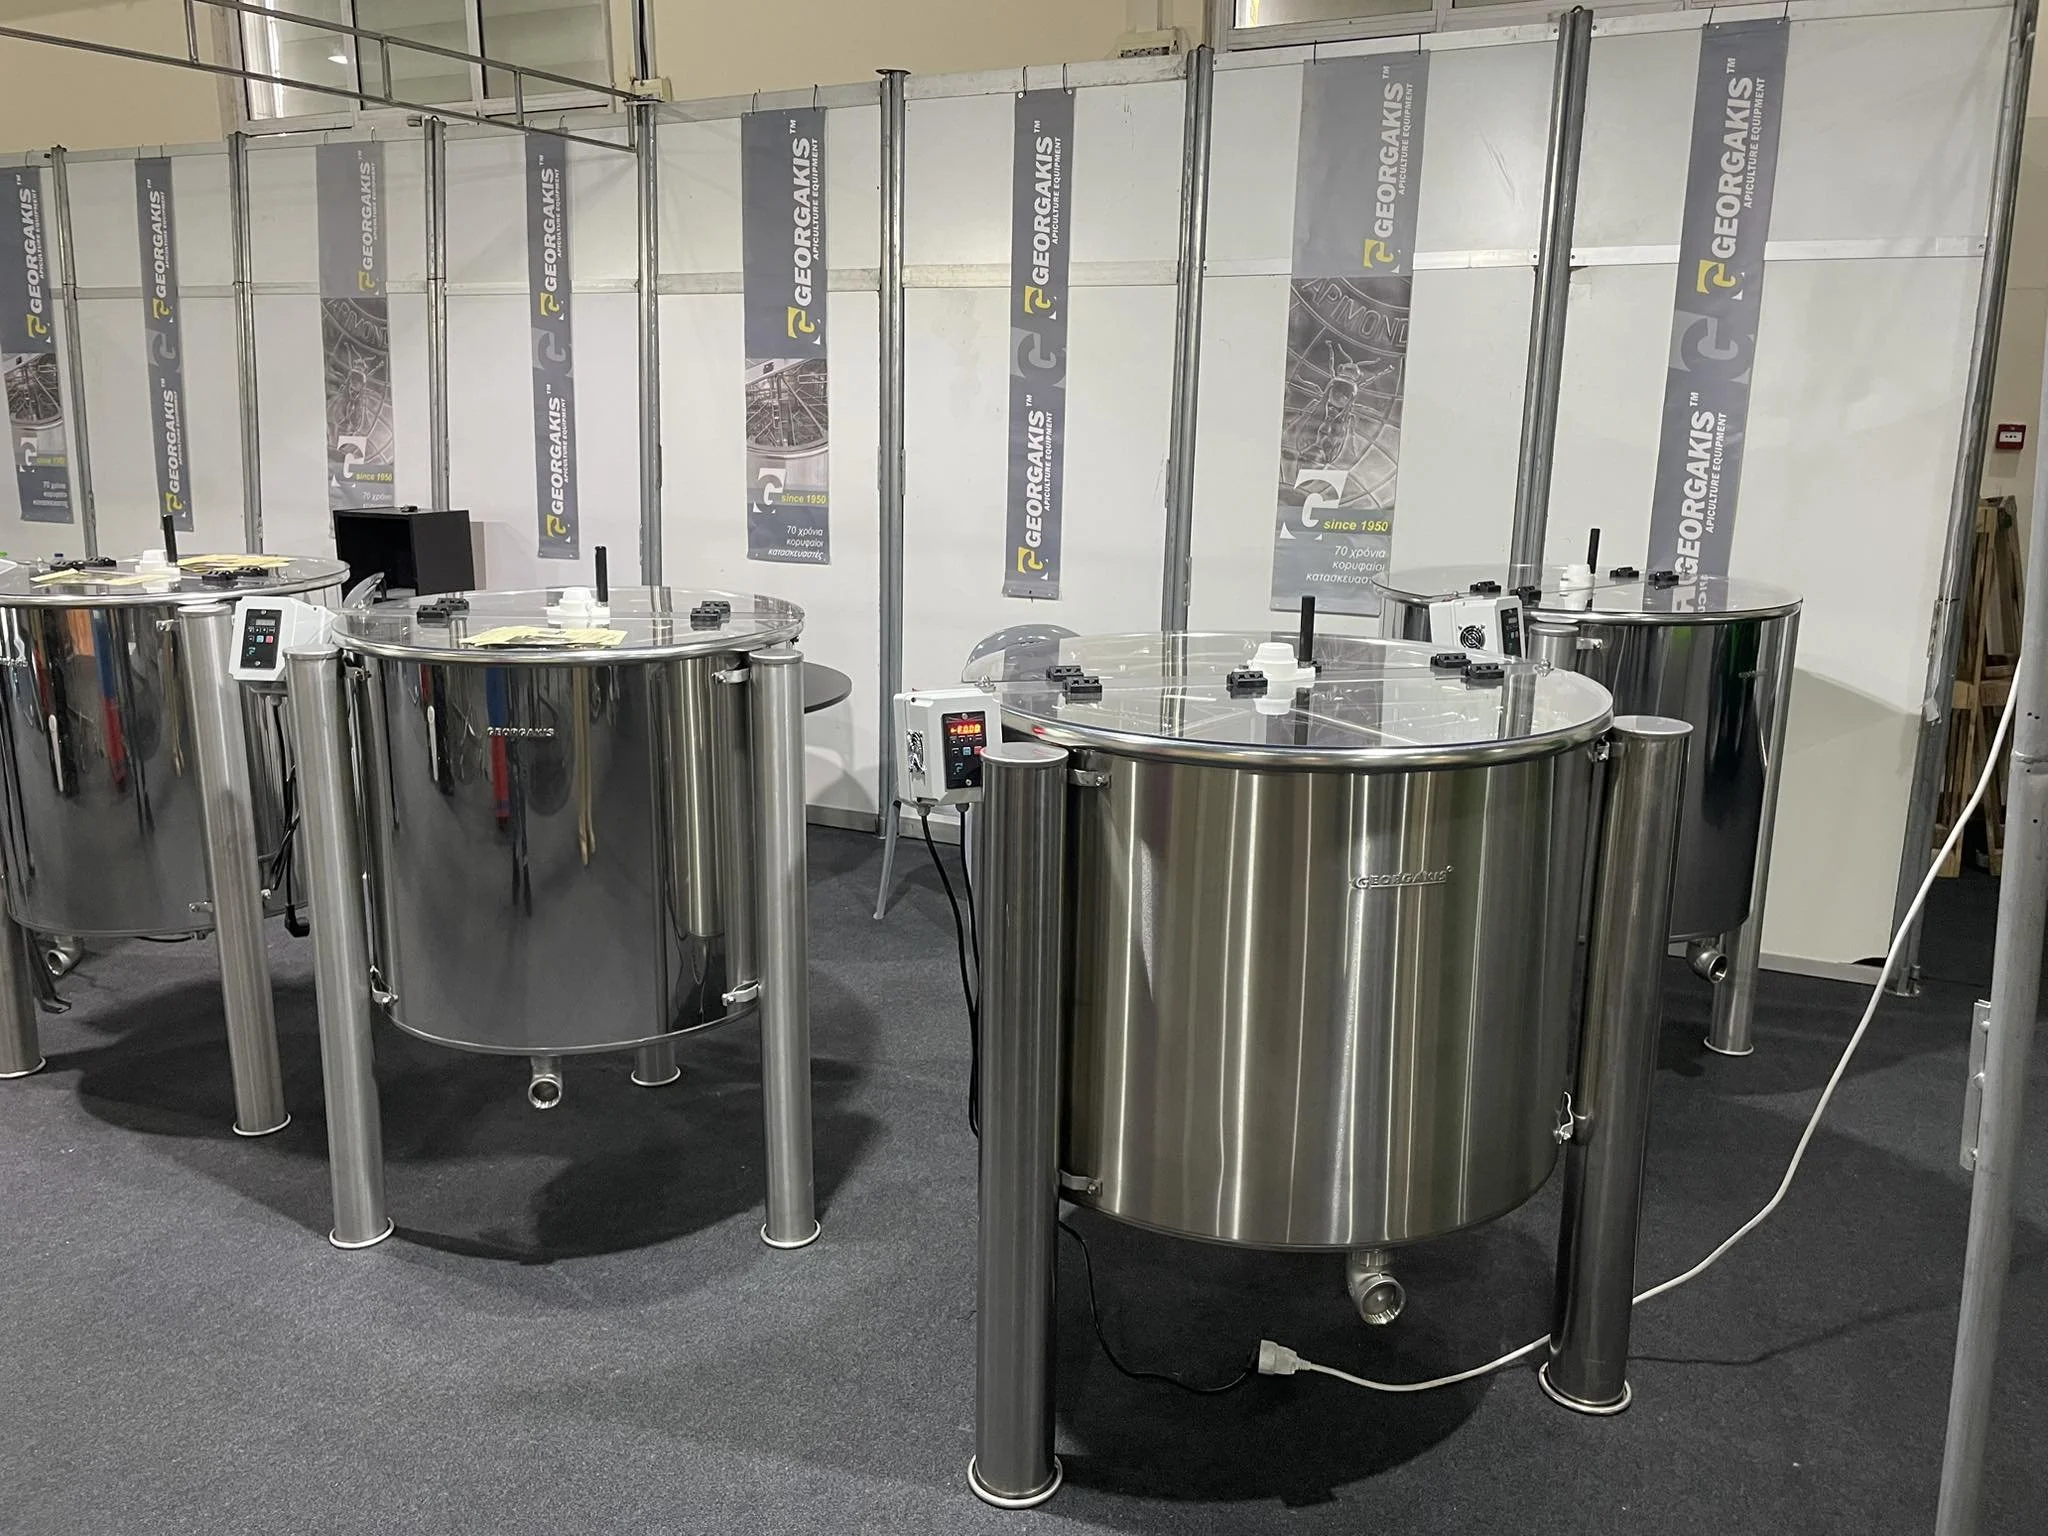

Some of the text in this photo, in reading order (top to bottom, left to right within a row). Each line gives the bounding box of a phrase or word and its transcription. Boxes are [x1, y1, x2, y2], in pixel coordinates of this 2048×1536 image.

[1052, 137, 1062, 245] APICULTURE EQUIPMENT
[1374, 82, 1403, 238] GEORGAKIS
[1399, 83, 1413, 195] APICULTURE EQUIPMENT
[1712, 77, 1753, 259] GEORGAKIS
[1744, 77, 1765, 209] APICULTURE EQUIPMENT
[20, 188, 43, 314] GEORGAKIS
[150, 190, 166, 298] GEORGAKIS
[360, 162, 373, 270] GEORGAKIS
[542, 168, 558, 292] GEORGAKIS
[792, 137, 812, 306] GEORGAKIS
[1032, 136, 1053, 286] GEORGAKIS
[164, 390, 180, 493] GEORGAKIS
[549, 397, 564, 515] GEORGAKIS
[782, 494, 827, 504] since 1950
[1026, 410, 1044, 548] GEORGAKIS
[1674, 411, 1715, 575] GEORGAKIS
[1705, 413, 1727, 534] APICULTURE EQUIPMENT
[787, 525, 823, 537] 70 χρόνια
[1306, 573, 1372, 584] κατασκευασ
[1323, 519, 1388, 532] since 1950
[1332, 561, 1385, 572] κορυφαίοι
[1335, 545, 1386, 559] 70 χρόνια
